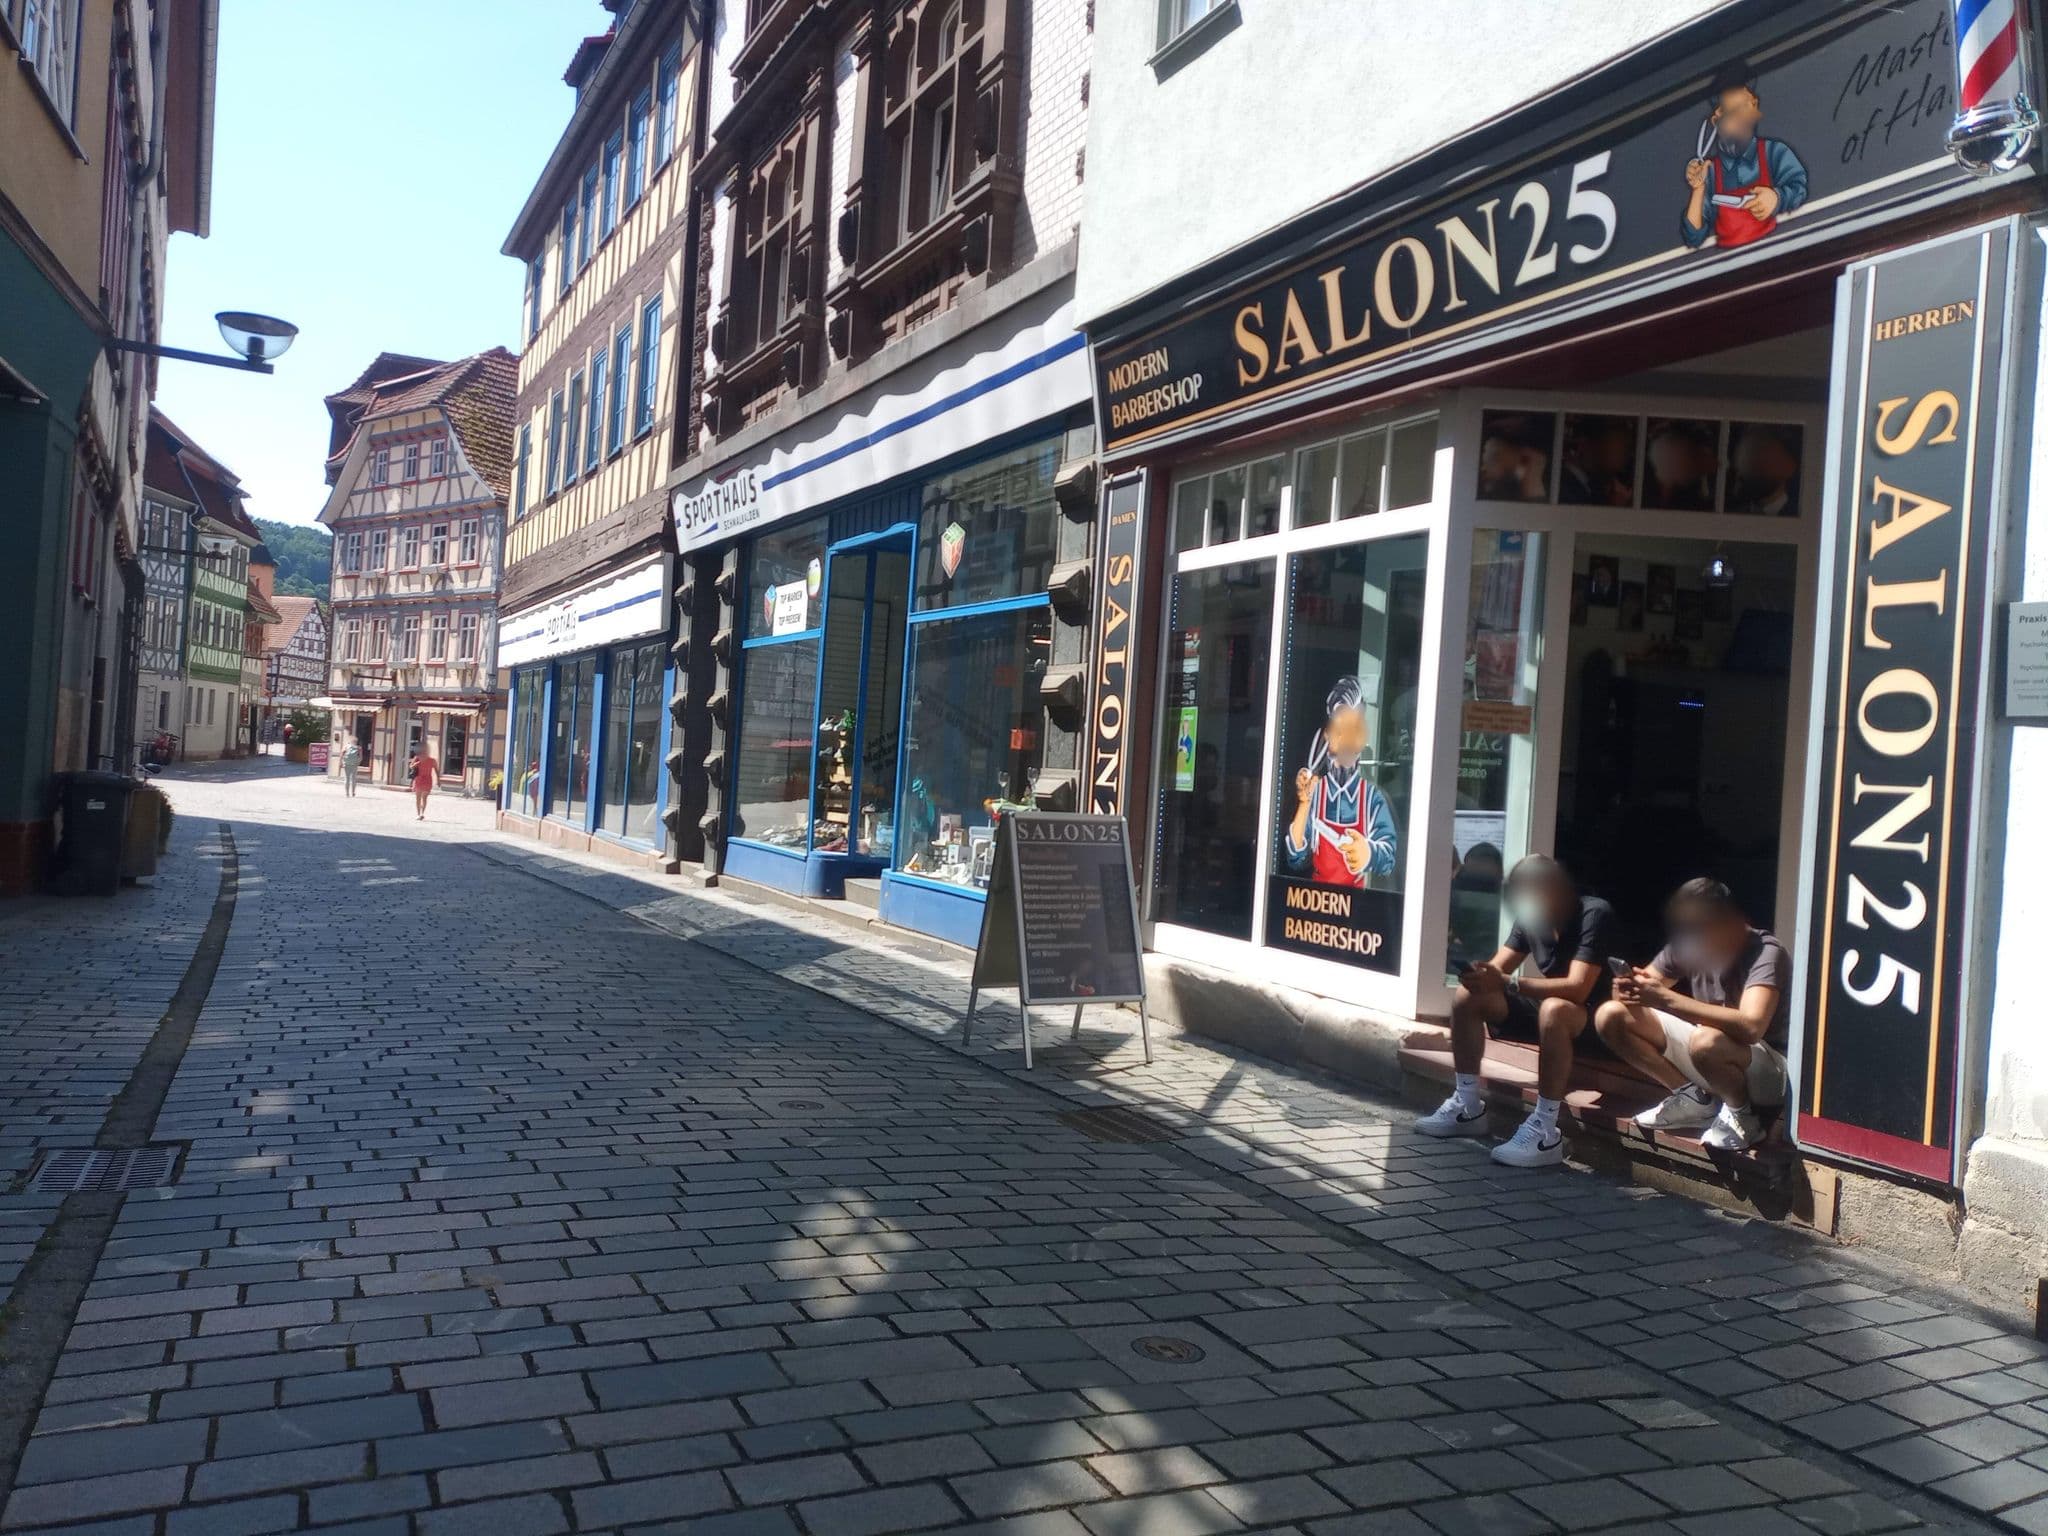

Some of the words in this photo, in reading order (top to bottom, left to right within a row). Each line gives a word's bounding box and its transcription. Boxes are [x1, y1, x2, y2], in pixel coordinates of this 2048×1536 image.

[1841, 108, 1883, 163] of
[1234, 150, 1617, 387] SALON25
[1875, 300, 1976, 342] HERREN
[1108, 346, 1169, 394] MODERN
[1112, 373, 1203, 429] BARBERSHOP
[684, 473, 757, 529] SPORTHAUS
[2019, 615, 2048, 624] Praxis
[1841, 389, 1960, 1015] SALON25
[1017, 823, 1121, 842] SALON25
[1286, 886, 1351, 917] MODERN
[1285, 917, 1382, 957] BARBERSHOP
